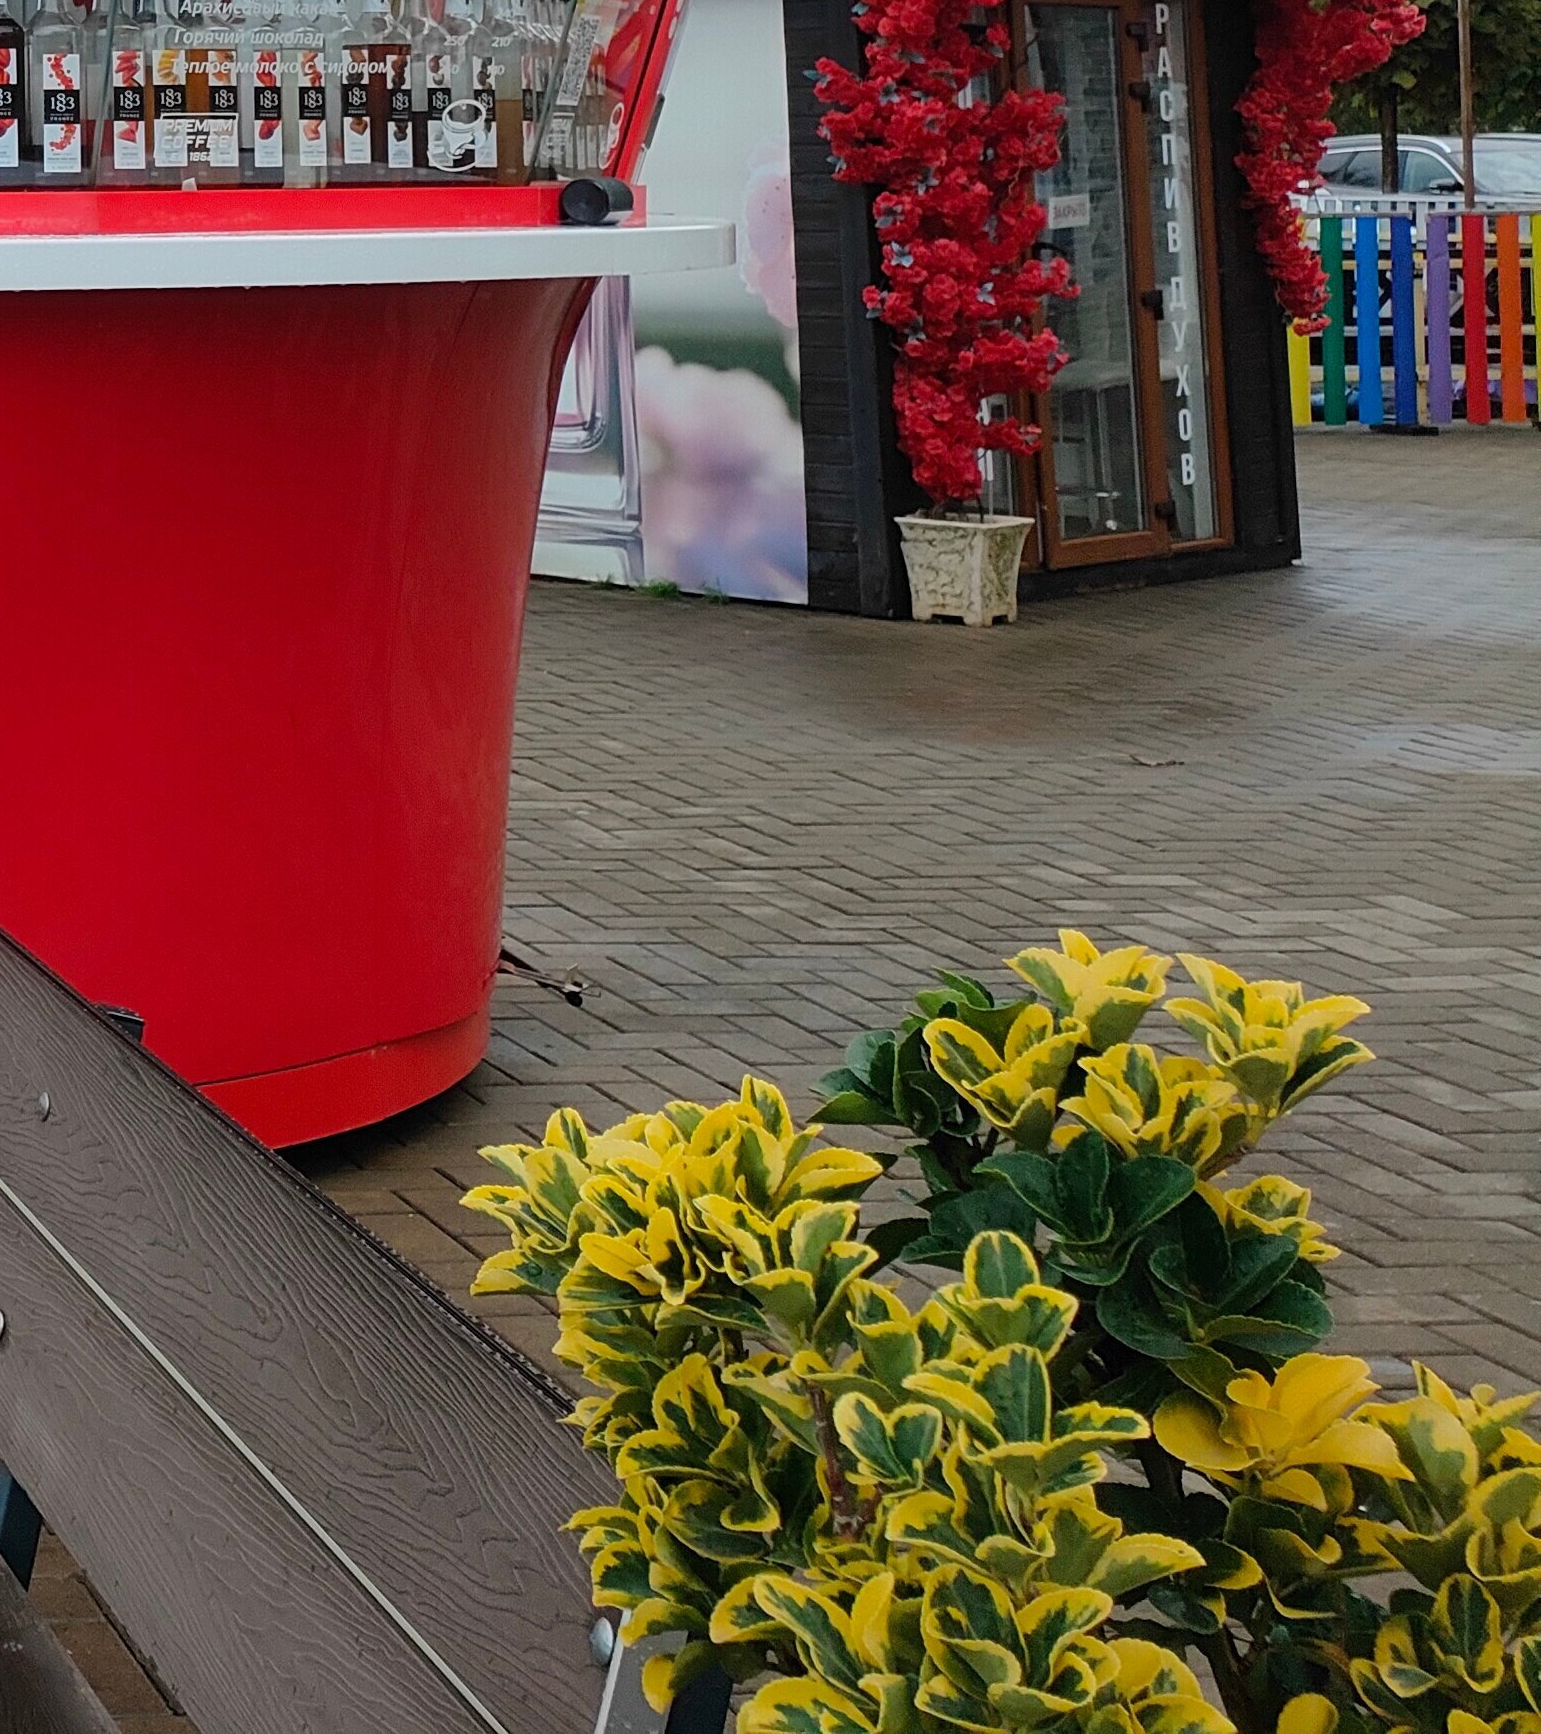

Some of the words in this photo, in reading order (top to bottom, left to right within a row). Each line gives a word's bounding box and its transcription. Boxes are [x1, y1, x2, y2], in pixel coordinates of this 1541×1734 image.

[174, 28, 245, 46] Горячий
[250, 30, 325, 48] шоколад
[444, 36, 466, 47] 250
[492, 36, 512, 48] 210
[173, 59, 232, 75] Теплое
[235, 61, 299, 75] молоко
[321, 62, 388, 77] сиропом
[50, 93, 75, 113] 1883
[119, 89, 141, 109] 1883
[160, 87, 183, 107] 1883
[214, 88, 235, 108] 1883
[259, 89, 279, 108] 1883
[303, 89, 323, 108] 1883
[348, 86, 367, 106] 1883
[392, 92, 410, 111] 1883
[432, 87, 449, 107] 1883
[162, 119, 234, 133] PREMIUM
[1154, 2, 1183, 254] РАСПИВ
[160, 135, 230, 149] COFFEE
[1168, 276, 1197, 487] ДУХОВ
